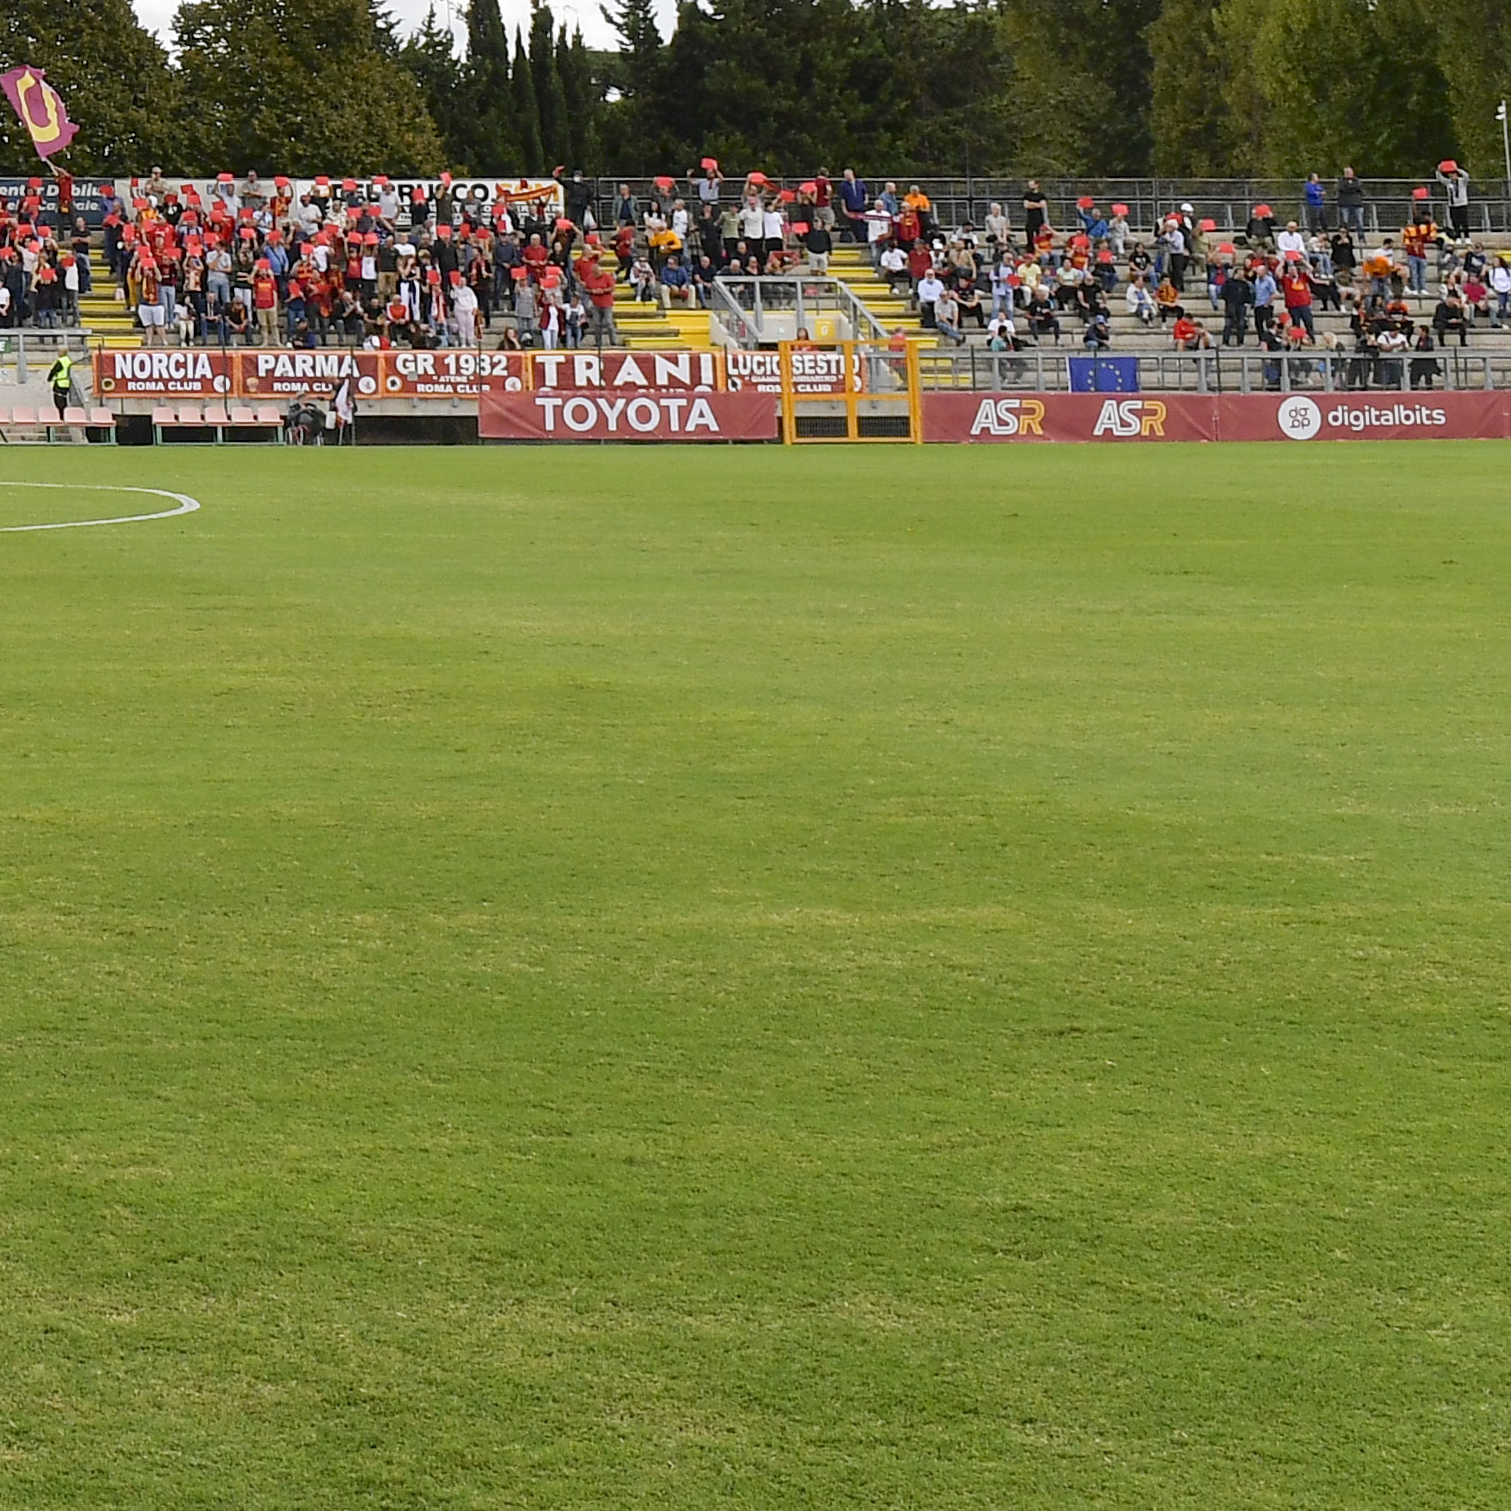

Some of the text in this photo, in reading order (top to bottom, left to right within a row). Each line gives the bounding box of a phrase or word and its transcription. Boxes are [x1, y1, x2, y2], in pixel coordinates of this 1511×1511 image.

[114, 353, 213, 379] NORCIA
[257, 354, 360, 378] PARMA
[396, 353, 436, 375] GR
[535, 353, 714, 387] TRANI
[128, 381, 202, 391] ROMA CLUB
[273, 382, 310, 392] ROMA
[416, 383, 454, 393] ROMA
[797, 384, 832, 393] CLUB
[534, 397, 720, 432] TOYOTA
[970, 399, 1046, 435] ASR
[1093, 399, 1167, 436] ASR
[1328, 404, 1447, 432] digitalbits
